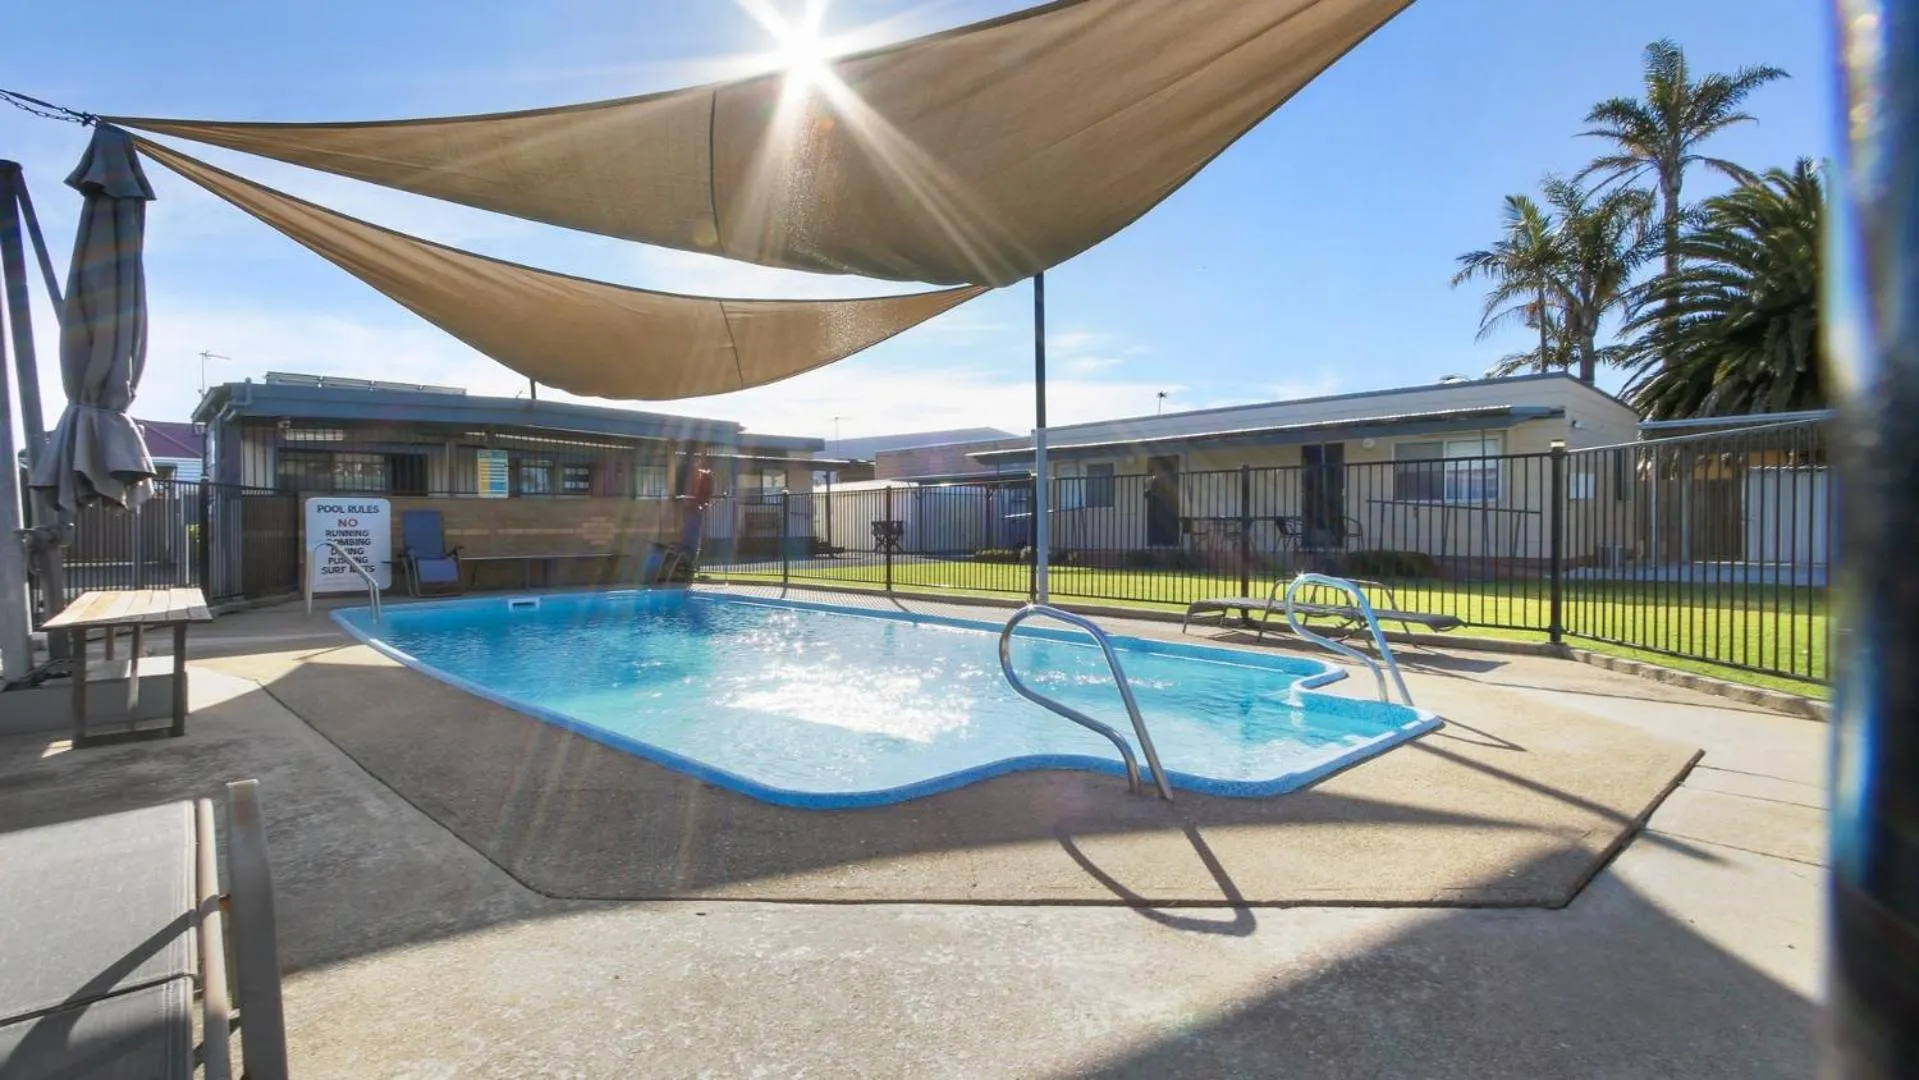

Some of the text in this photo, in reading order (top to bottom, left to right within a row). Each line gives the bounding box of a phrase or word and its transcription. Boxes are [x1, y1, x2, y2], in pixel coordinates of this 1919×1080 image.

[316, 505, 380, 514] POOL RULES
[337, 519, 358, 527] NO
[320, 566, 346, 575] SURF
